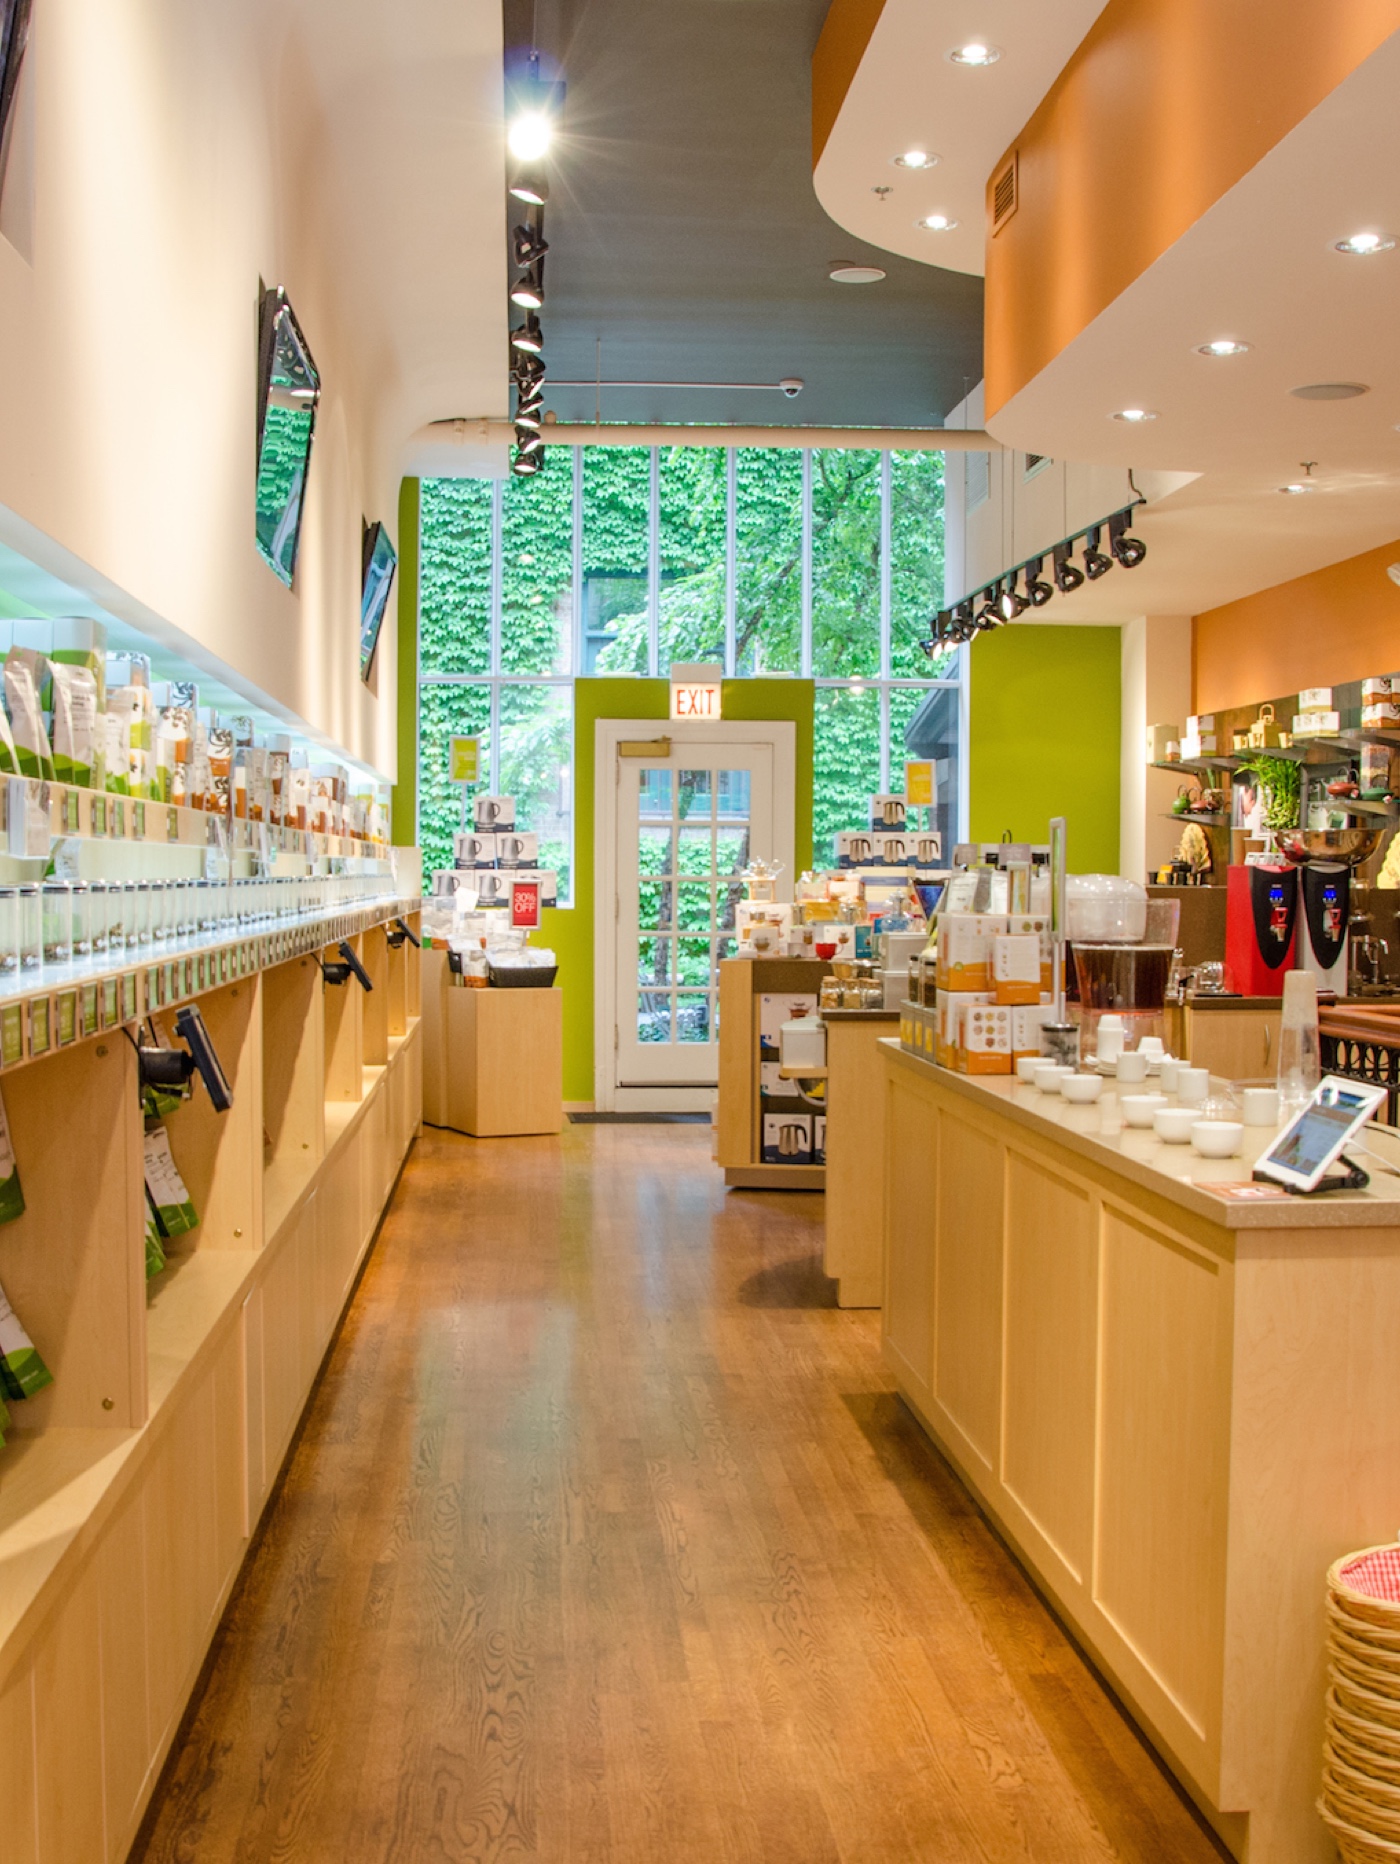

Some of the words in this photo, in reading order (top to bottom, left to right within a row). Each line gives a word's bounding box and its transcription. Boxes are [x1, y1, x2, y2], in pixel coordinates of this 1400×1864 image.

[677, 689, 714, 715] EXIT
[515, 892, 536, 902] 30%
[515, 902, 536, 913] OFF
